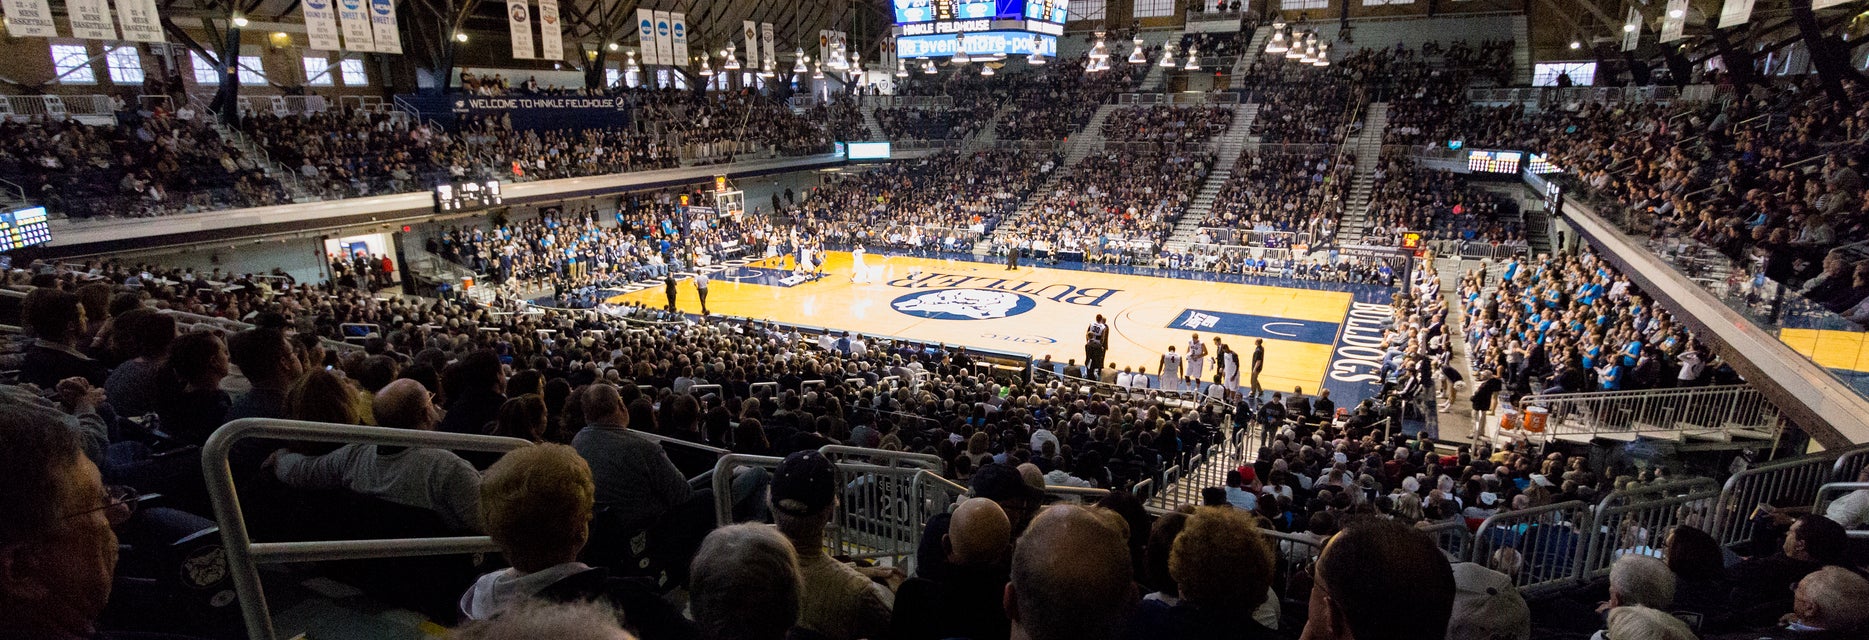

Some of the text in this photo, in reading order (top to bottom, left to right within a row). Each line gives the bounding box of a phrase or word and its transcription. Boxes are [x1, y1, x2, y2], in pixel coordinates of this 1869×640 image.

[341, 11, 358, 20] SWEET
[373, 16, 390, 24] SWEET
[72, 21, 112, 30] BASKETBALL
[123, 24, 160, 32] BASKETBALL
[903, 20, 990, 36] HINKLE FIELDHOUSE
[469, 99, 614, 109] WELCOME TO HINKLE FIELDHOUSE
[886, 272, 1125, 307] BUTLER
[1330, 301, 1394, 383] BULLDOGS
[880, 495, 908, 522] 20
